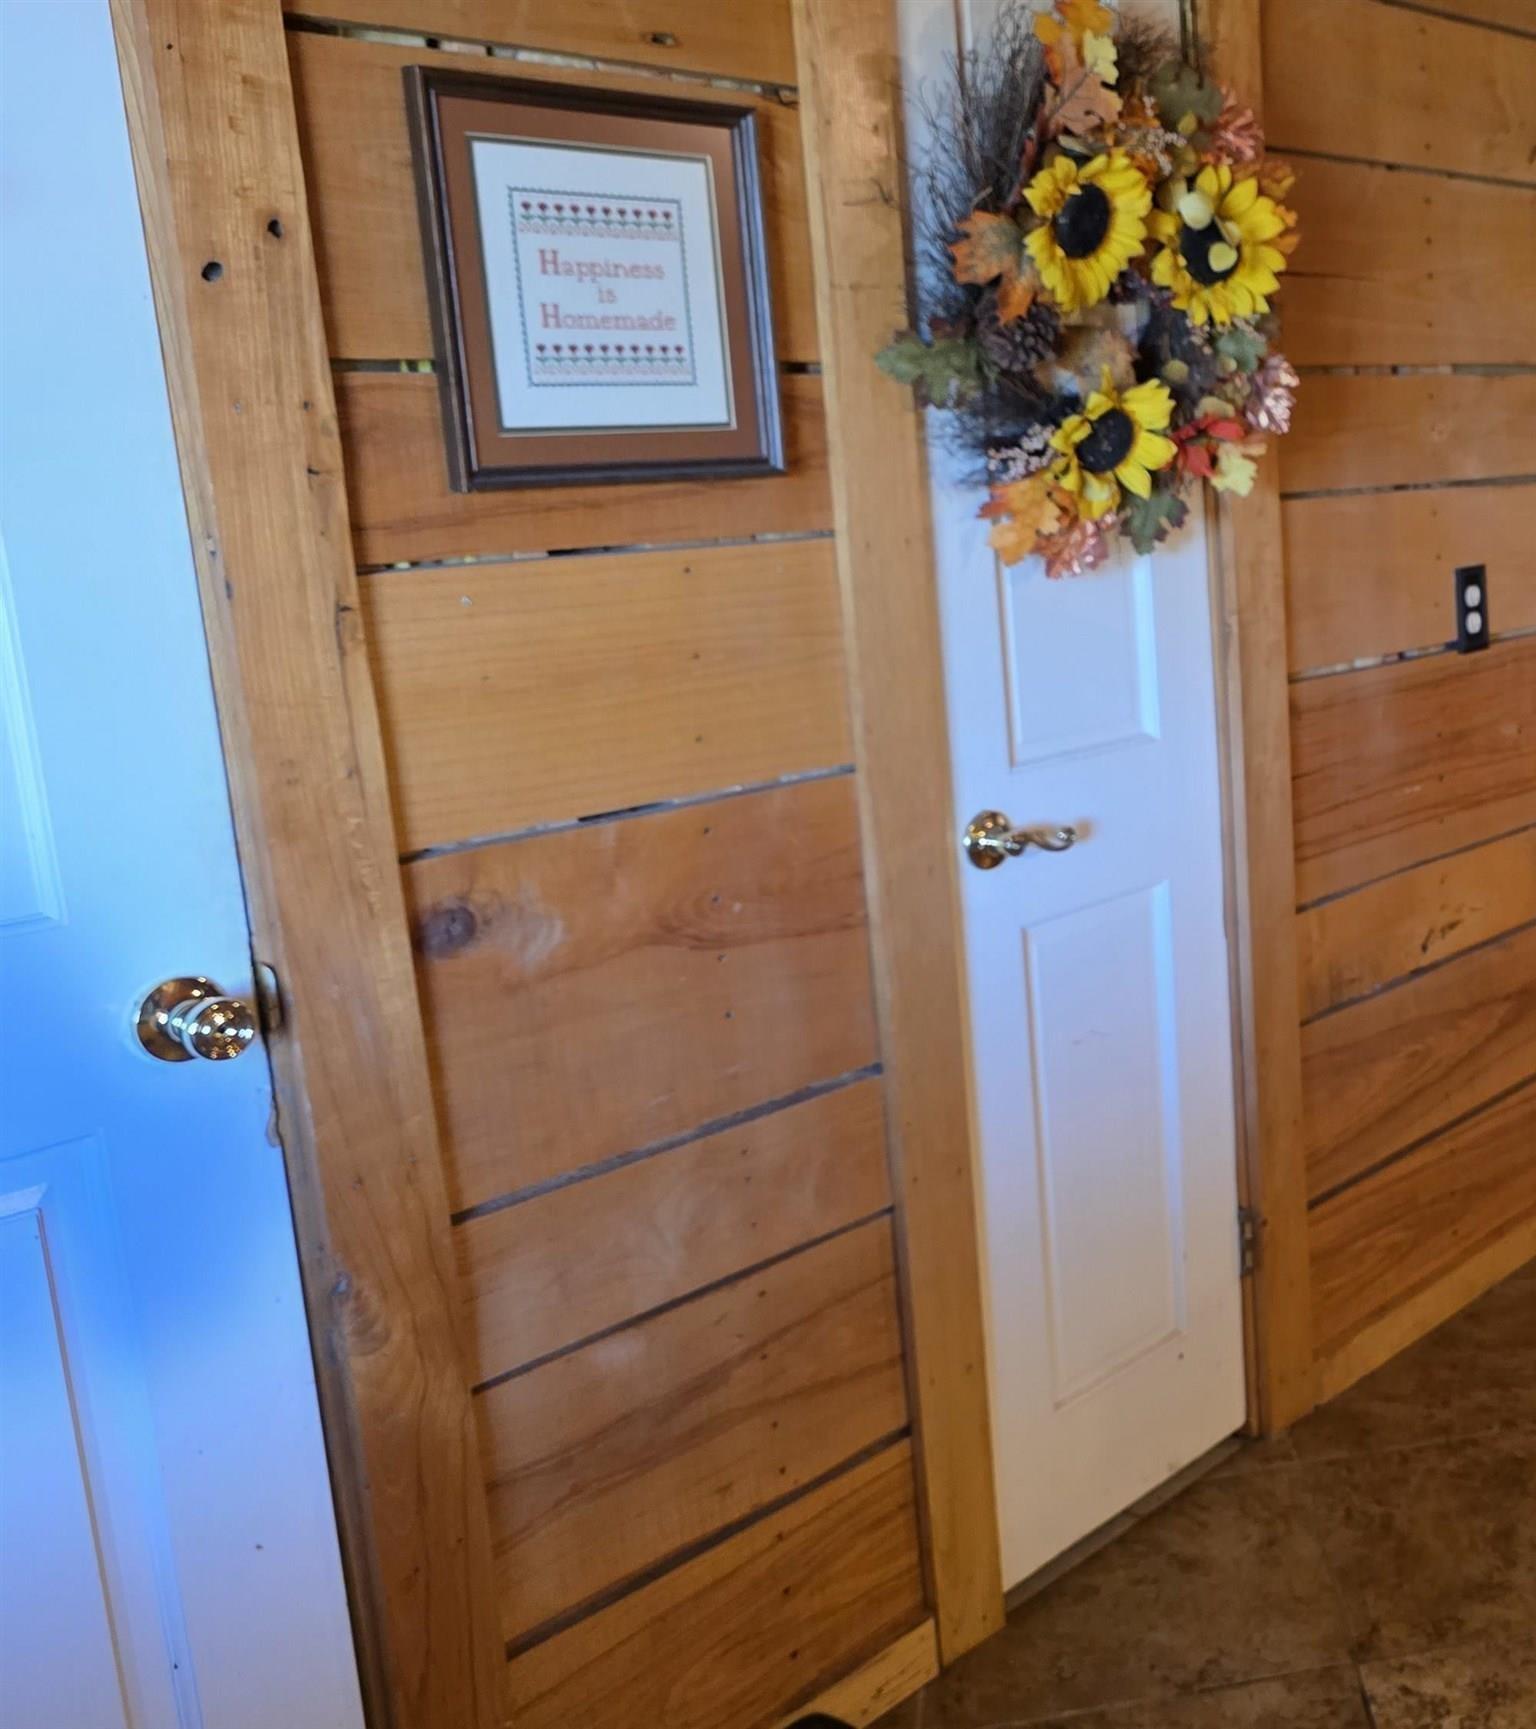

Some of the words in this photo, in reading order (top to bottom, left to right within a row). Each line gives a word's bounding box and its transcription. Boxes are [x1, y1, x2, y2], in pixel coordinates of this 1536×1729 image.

[538, 248, 665, 283] Happiness
[597, 288, 618, 304] is
[540, 302, 677, 331] Homemade
